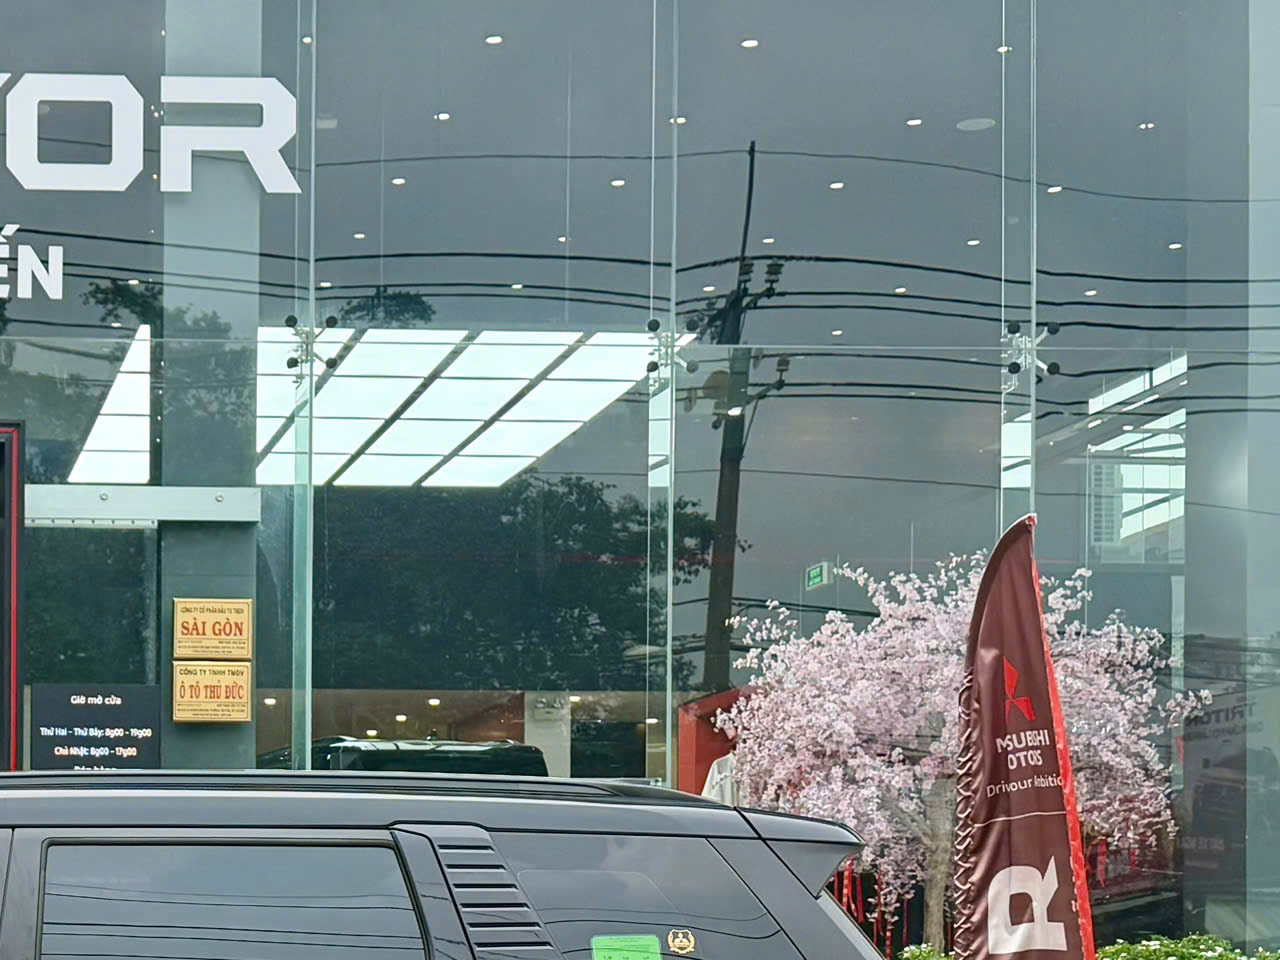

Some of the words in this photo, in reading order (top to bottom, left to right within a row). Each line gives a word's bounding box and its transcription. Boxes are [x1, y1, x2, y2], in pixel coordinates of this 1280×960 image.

[181, 617, 207, 636] SÀI
[212, 617, 244, 636] GÒN
[179, 668, 197, 676] CÔNG
[70, 695, 86, 704] Giờ
[88, 695, 103, 704] mở
[104, 695, 122, 704] cửa
